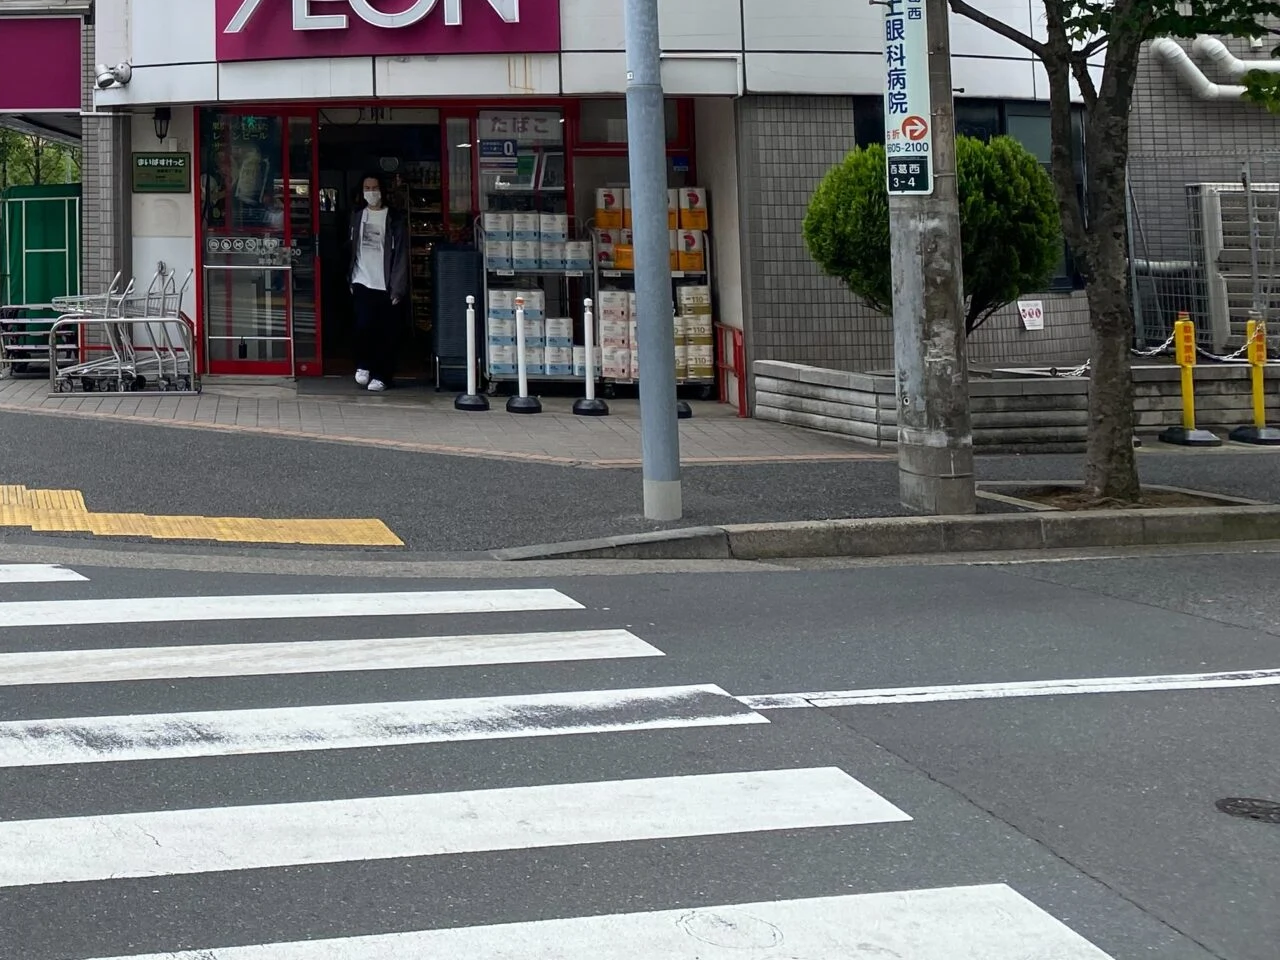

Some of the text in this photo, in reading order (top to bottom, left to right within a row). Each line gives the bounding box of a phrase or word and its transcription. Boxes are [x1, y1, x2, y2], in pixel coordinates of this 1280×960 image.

[491, 116, 549, 133] たばこ
[137, 158, 185, 166] まいばすけっと
[893, 177, 916, 187] 3-4
